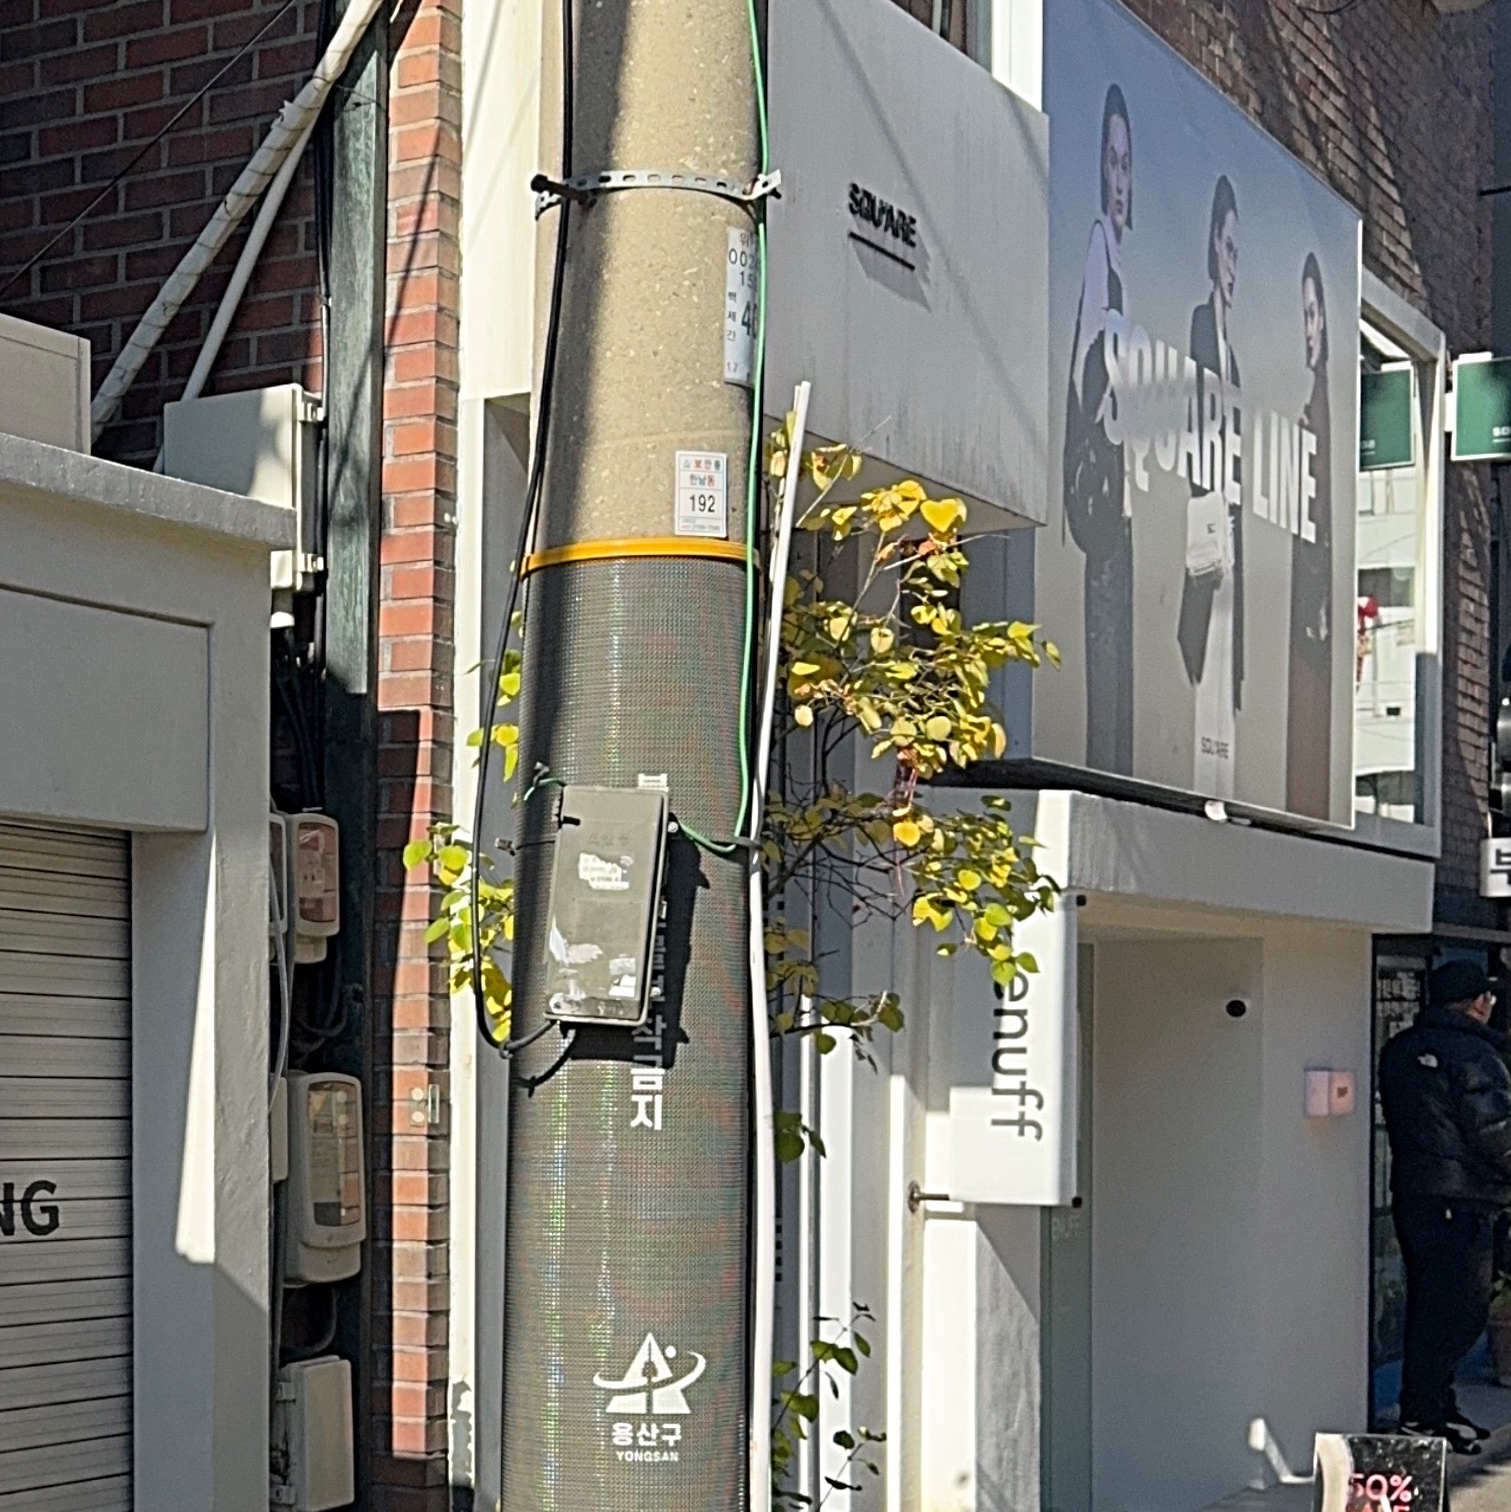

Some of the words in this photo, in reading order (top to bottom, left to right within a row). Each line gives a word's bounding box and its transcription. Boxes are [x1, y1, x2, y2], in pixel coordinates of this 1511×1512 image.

[849, 182, 916, 248] SQUARE
[1104, 308, 1242, 506] SQUARE
[1252, 409, 1317, 544] LINE
[689, 494, 716, 513] 192
[612, 1422, 682, 1447] 용산구
[615, 1450, 680, 1462] YONGSAN
